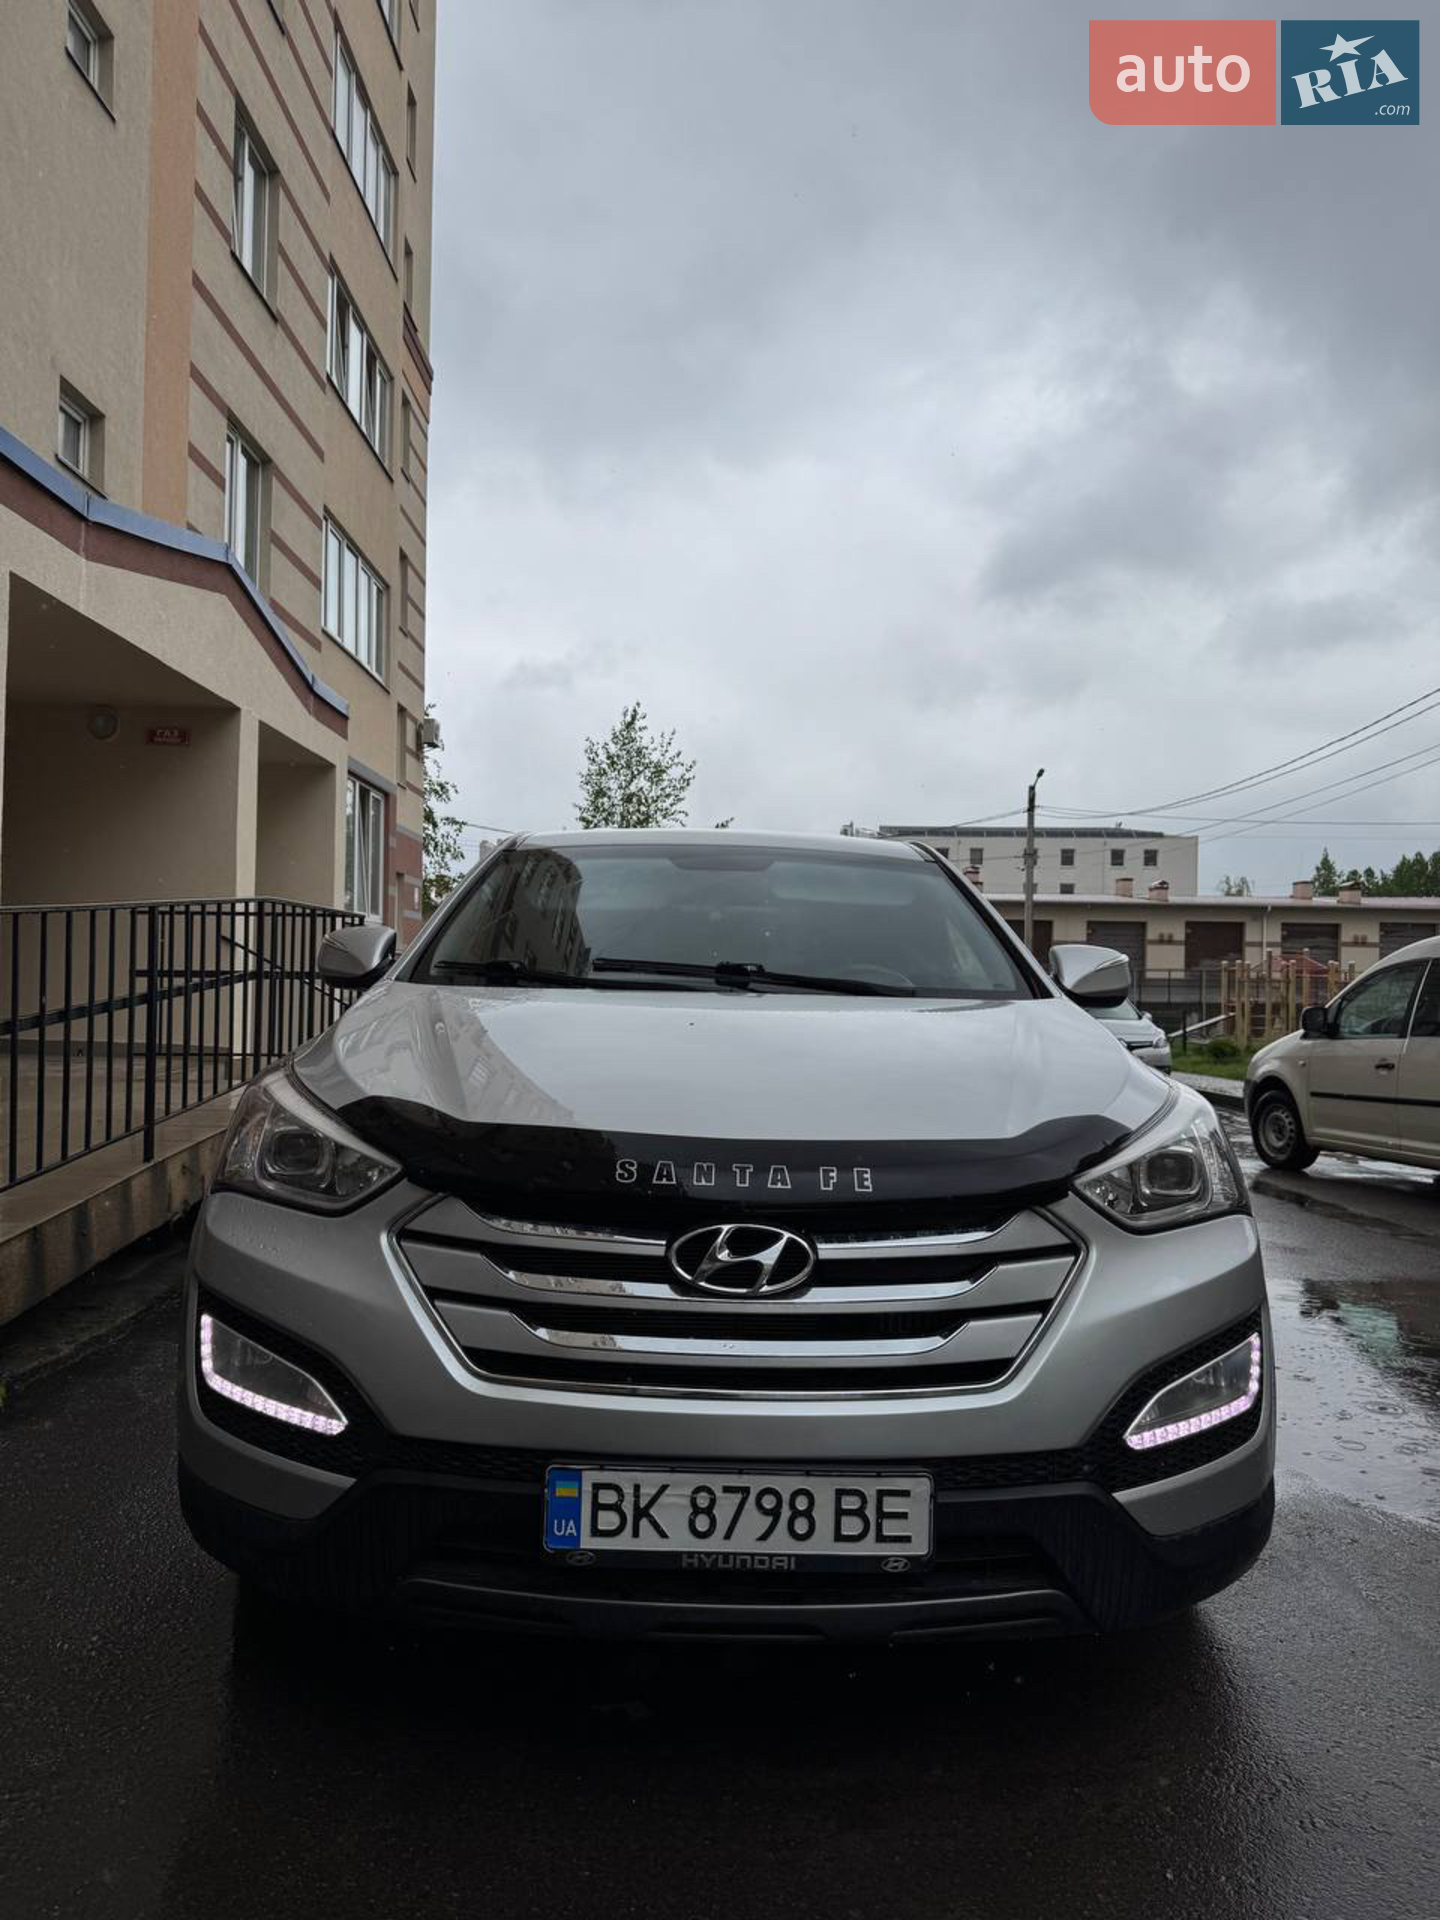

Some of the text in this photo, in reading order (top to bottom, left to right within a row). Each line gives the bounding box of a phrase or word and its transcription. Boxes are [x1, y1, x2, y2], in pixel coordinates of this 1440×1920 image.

[615, 1158, 873, 1192] SANTA FE
[589, 1482, 913, 1544] BK 8798 BE
[552, 1519, 578, 1537] UA
[681, 1552, 797, 1571] HYUNDAI
